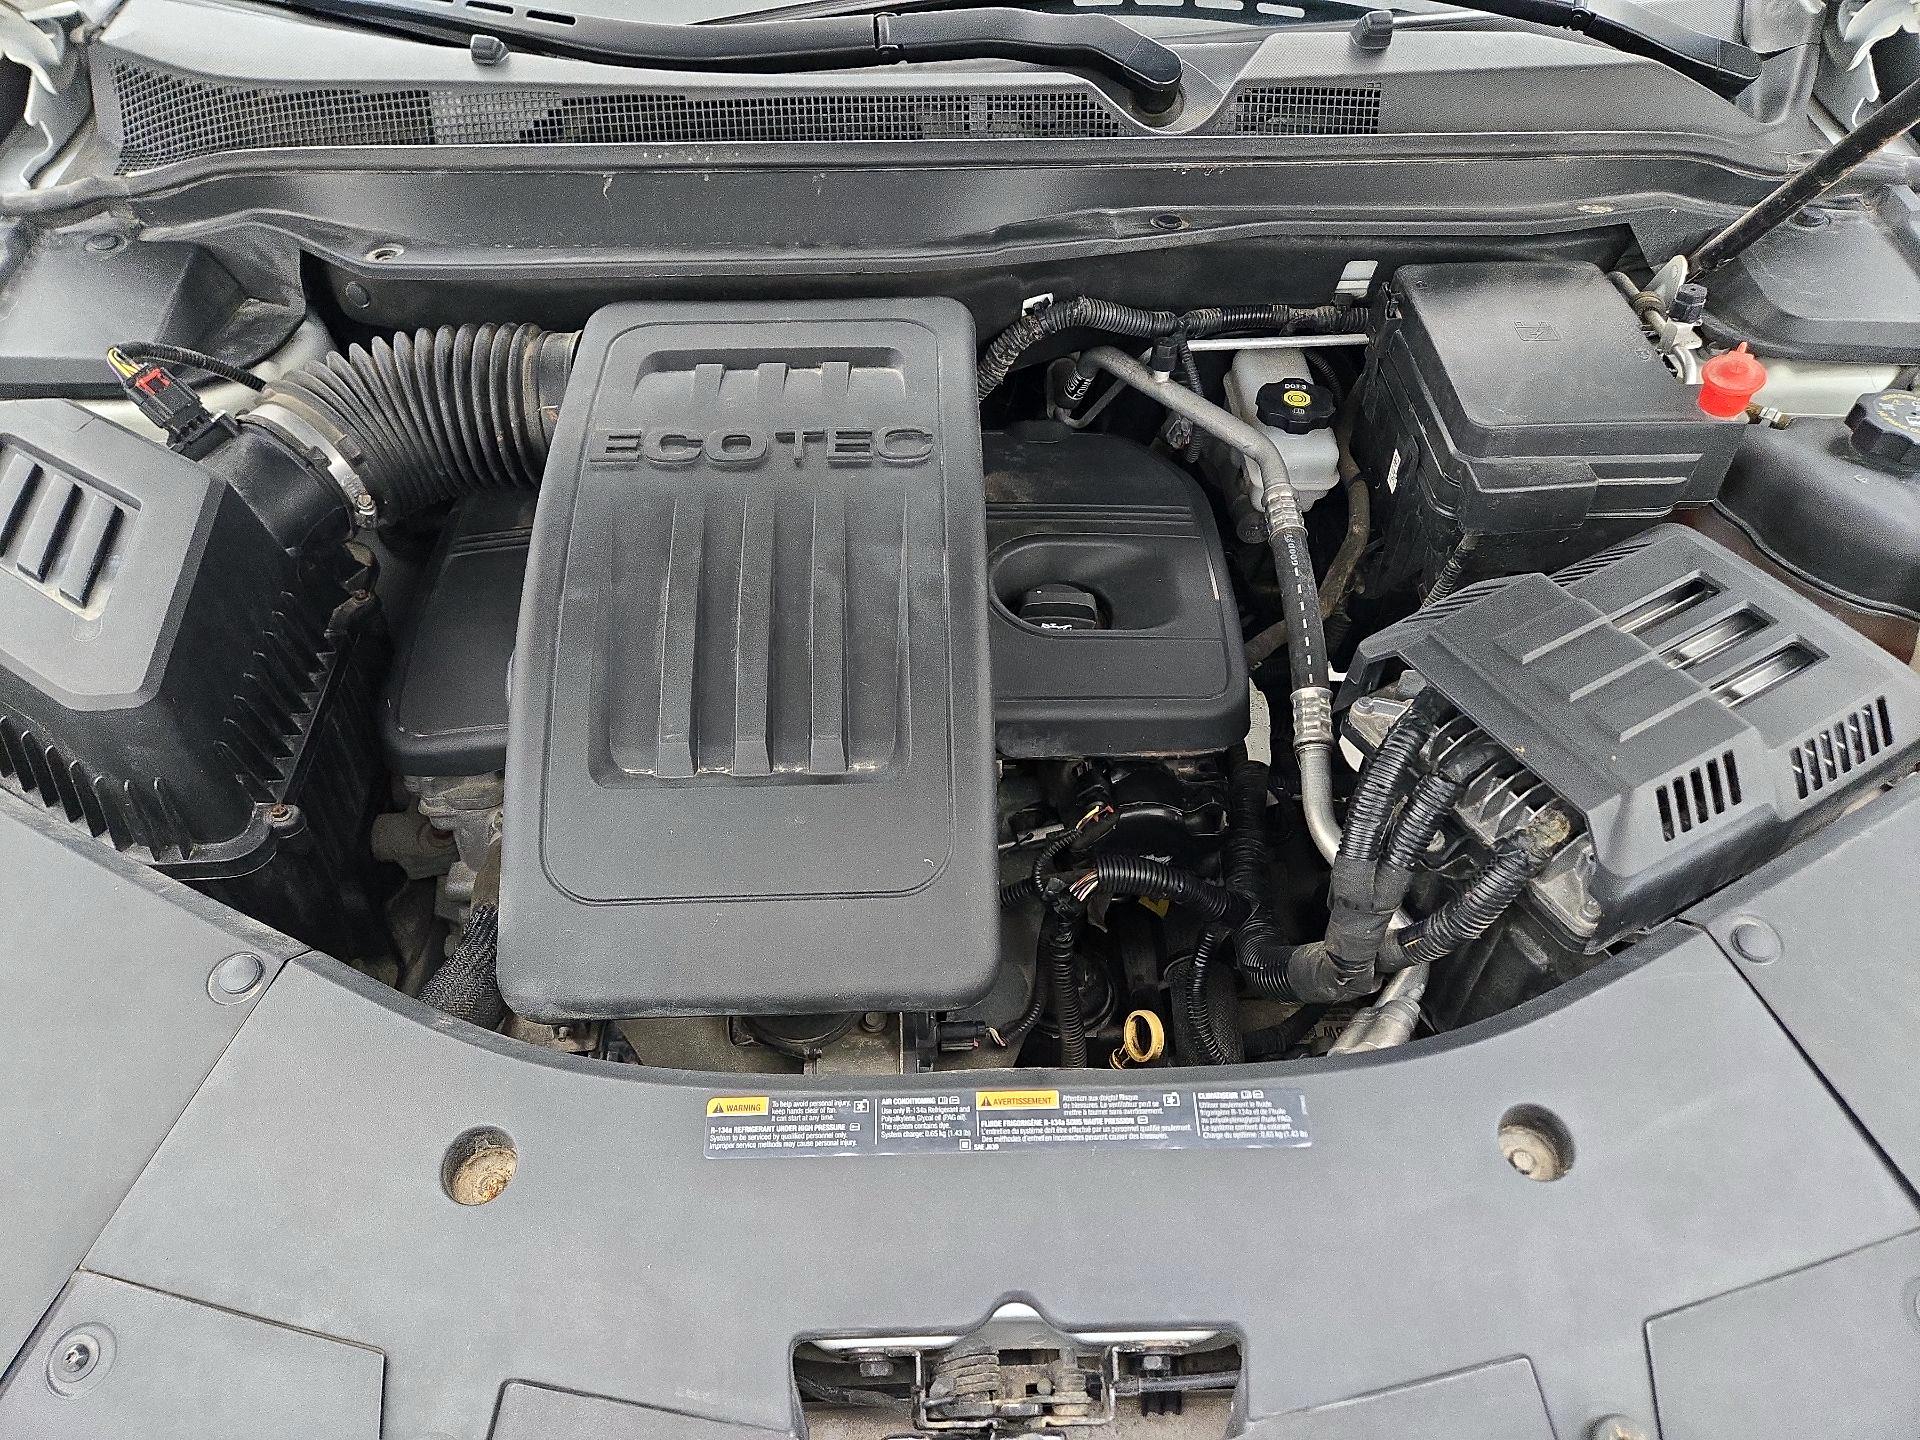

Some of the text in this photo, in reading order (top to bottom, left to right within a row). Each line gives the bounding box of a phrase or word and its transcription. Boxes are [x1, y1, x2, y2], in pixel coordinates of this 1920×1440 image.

[590, 427, 934, 468] ECOTEC
[810, 1100, 833, 1108] personal
[993, 1097, 1052, 1105] AVERTISSEMENT
[726, 1104, 761, 1112] WARNING
[893, 1107, 905, 1115] only
[928, 1106, 958, 1114] Refrigerant
[734, 1125, 776, 1133] REFRIGERANT
[777, 1124, 797, 1132] UNDER
[798, 1124, 813, 1132] HIGH
[893, 1123, 914, 1131] system
[914, 1122, 938, 1130] contains
[710, 1134, 731, 1142] System
[773, 1133, 780, 1141] by
[806, 1132, 834, 1140] personnel
[835, 1132, 848, 1140] only.
[881, 1131, 902, 1139] System
[939, 1130, 946, 1138] kg
[840, 1139, 857, 1147] injury.
